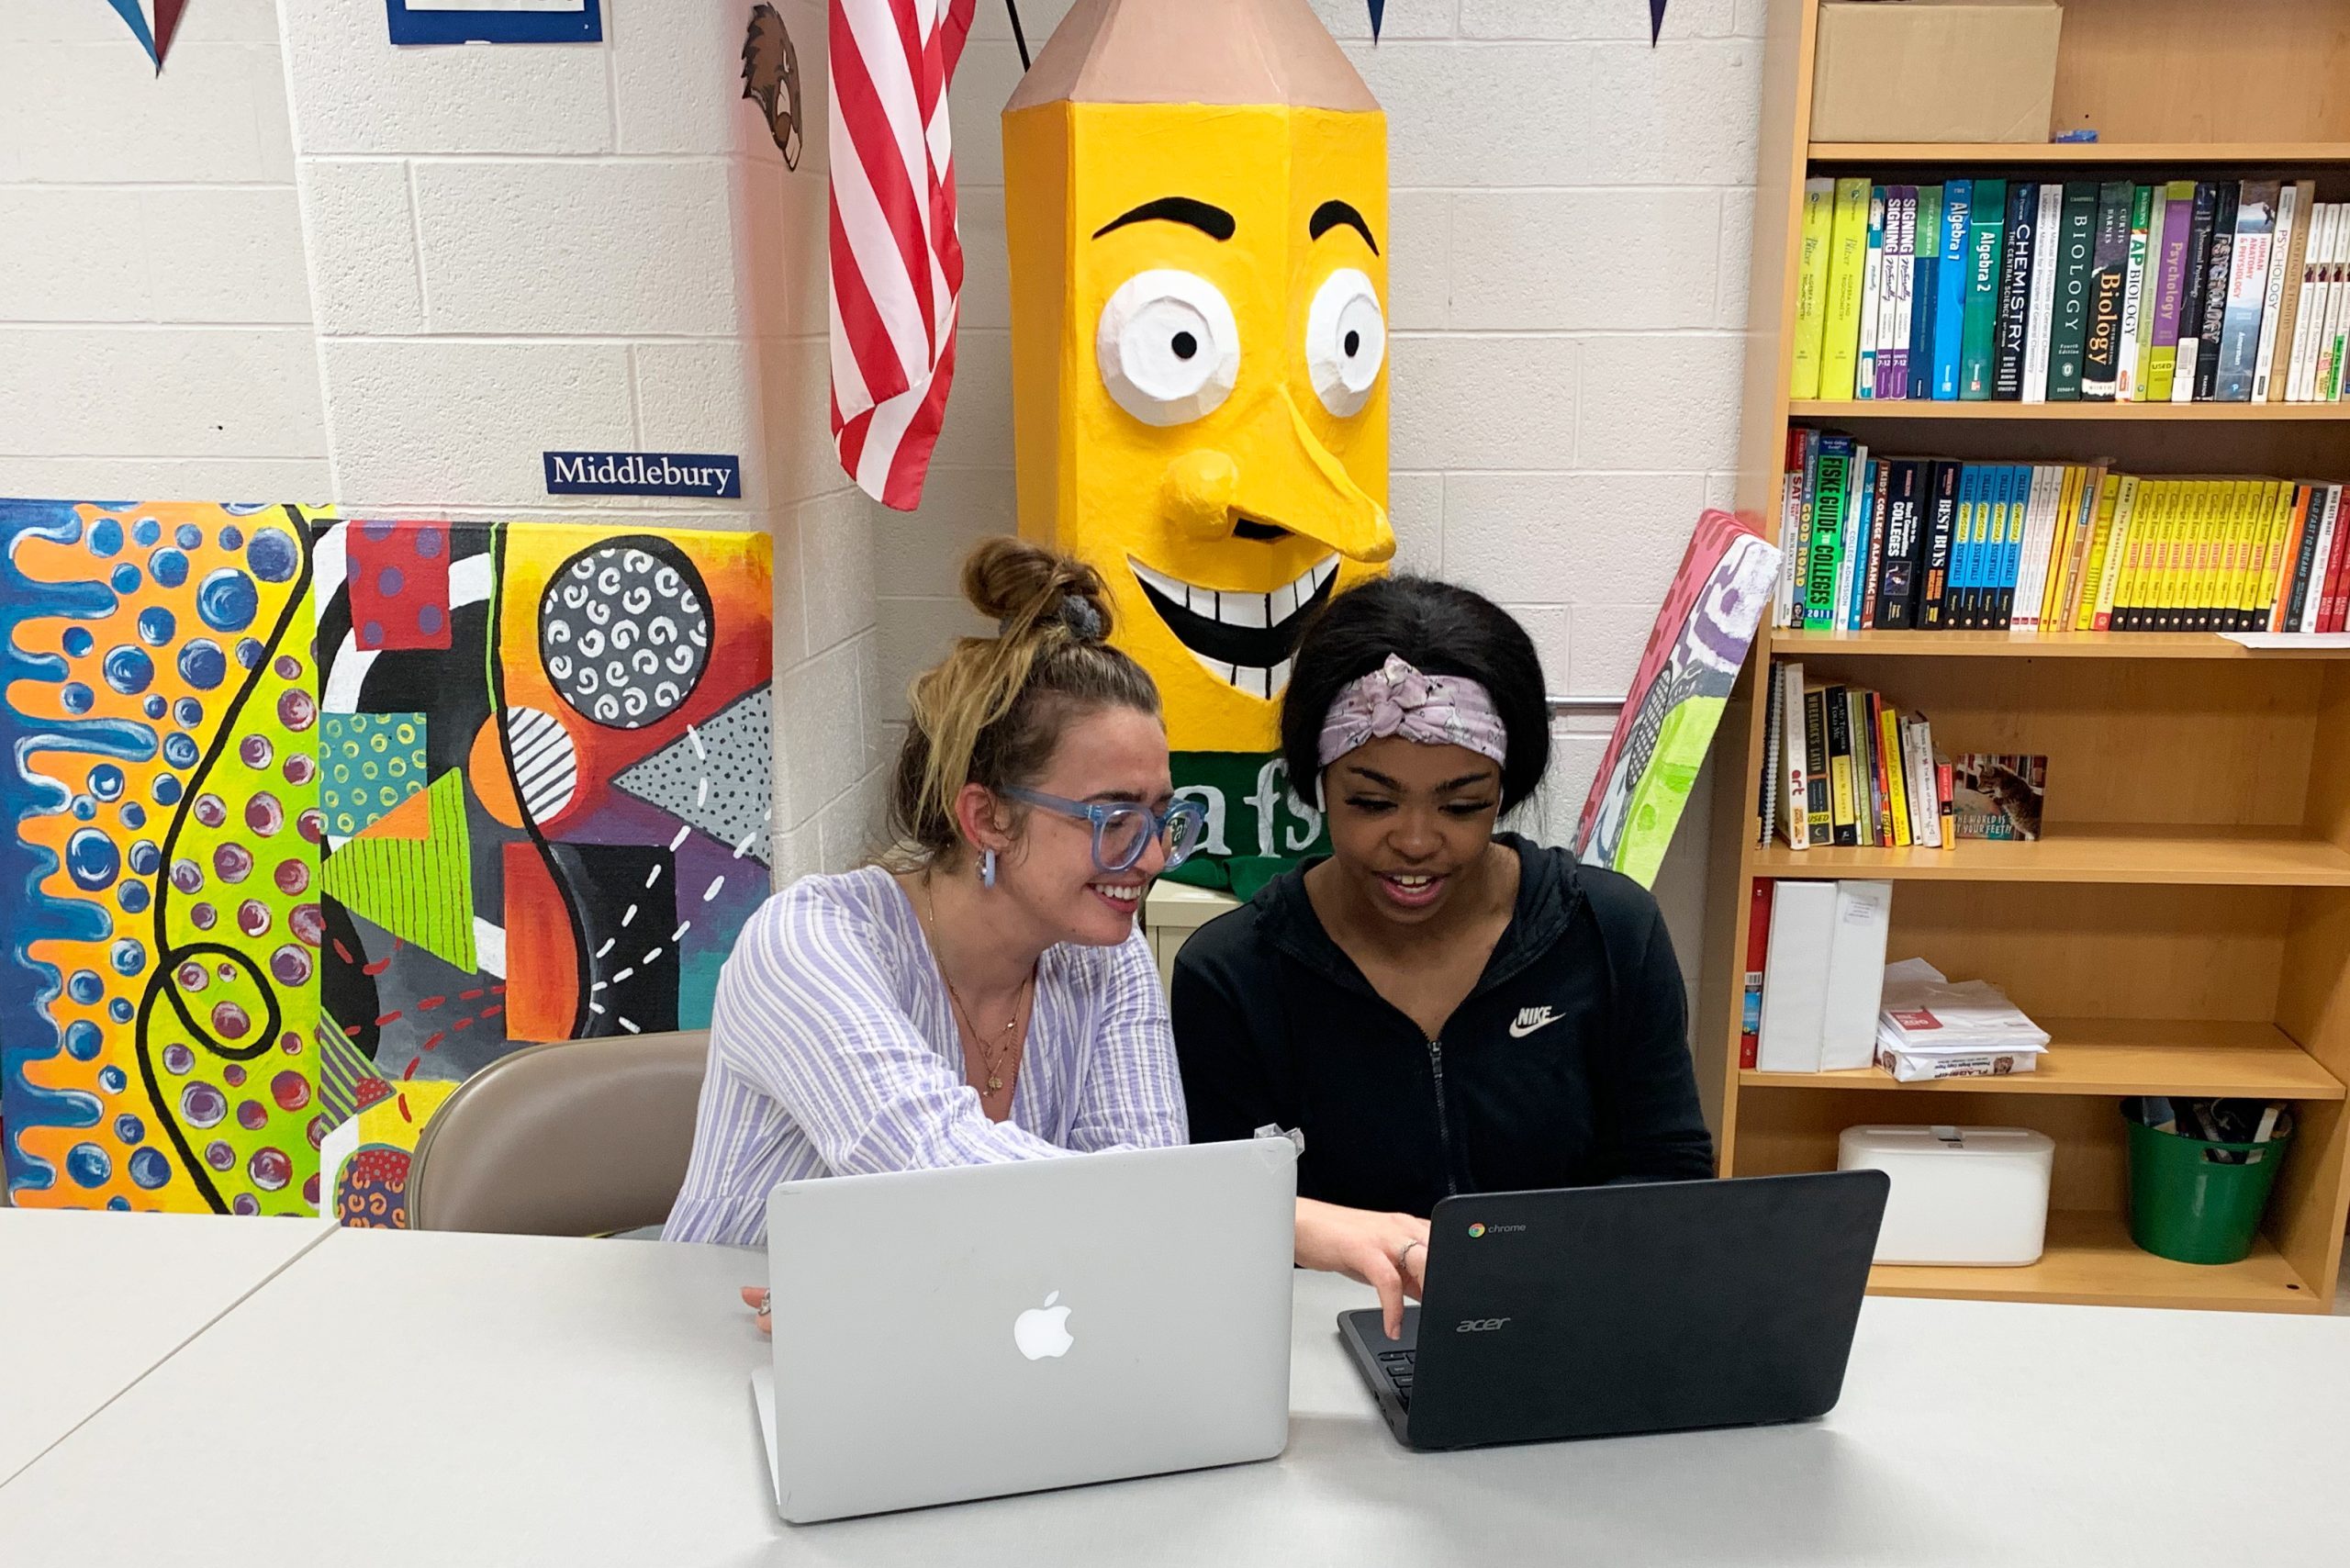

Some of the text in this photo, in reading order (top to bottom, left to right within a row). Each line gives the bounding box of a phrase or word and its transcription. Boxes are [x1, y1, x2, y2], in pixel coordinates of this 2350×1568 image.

[1947, 202, 1967, 251] Algebra
[2104, 208, 2115, 244] BARNES
[2117, 208, 2128, 244] CURTIS
[1883, 198, 1901, 302] SIGNING Naturally
[1897, 198, 1917, 302] SIGNING Naturally
[1975, 231, 1996, 292] Algebra 2
[2196, 229, 2208, 263] Abnormal
[2246, 237, 2257, 279] ANATOMY
[2256, 237, 2266, 272] HUMAN
[2007, 249, 2015, 284] CENTRAL
[2065, 216, 2088, 330] BIOLOGY
[2162, 241, 2185, 320] Psychology
[2190, 265, 2205, 298] Psychology
[2232, 245, 2246, 299] PHYSIOLOGY
[2268, 230, 2288, 310] PSYCHOLOGY
[2002, 286, 2011, 319] SCIENCE
[2008, 223, 2031, 353] CHEMISTRY
[2123, 238, 2145, 337] AP BIOLOGY
[2202, 232, 2232, 344] PSYCHOLOGY
[2314, 287, 2326, 324] Essentials
[2088, 273, 2121, 366] Biology
[2309, 332, 2321, 364] Sociology
[553, 455, 733, 496] Middlebury
[1791, 476, 1802, 501] SAT
[1804, 456, 1816, 493] choosing
[1936, 498, 1953, 532] BEST
[2311, 492, 2322, 514] HOLD
[2327, 505, 2336, 519] GETS
[2330, 490, 2339, 504] WHO
[1799, 502, 1812, 543] GOOD
[1809, 458, 1843, 604] FISKE GUIDE TO COLLEGES
[1873, 497, 1885, 539] COLLEGE
[1887, 501, 1906, 557] COLLEGES
[1899, 501, 1913, 557] Most Competitive
[2133, 493, 2150, 540] College Essay
[2147, 493, 2164, 540] College Essay
[2161, 493, 2177, 540] College Essay
[2175, 493, 2191, 540] College Essay
[2188, 493, 2205, 540] College Essay
[2203, 493, 2219, 540] College Essay
[2215, 493, 2232, 540] College Essay
[2230, 493, 2245, 540] College Essay
[2244, 493, 2259, 540] College Essay
[2258, 495, 2274, 542] College Essay
[2276, 493, 2292, 540] College Essay
[2307, 515, 2318, 533] FAST
[2324, 521, 2334, 536] WHAT
[1787, 532, 1796, 566] BIOLOGY
[1846, 530, 1856, 563] COLLEGE
[1931, 535, 1948, 567] BUYS
[2103, 510, 2127, 606] The Passionate Teacher
[2305, 535, 2314, 545] TO
[1796, 546, 1808, 588] ROAD
[1867, 543, 1883, 595] ALMANAC
[1953, 543, 1964, 581] ESSENTIALS
[1970, 543, 1982, 581] ESSENTIALS
[1986, 543, 1999, 581] ESSENTIALS
[2004, 543, 2018, 581] ESSENTIALS
[2299, 546, 2313, 578] DREAMS
[1841, 566, 1852, 607] ADMISSION
[1807, 610, 1833, 620] 2011
[2324, 597, 2333, 615] FRANK
[1807, 697, 1821, 745] WHEELOCK'S
[1809, 748, 1822, 772] LATIN
[1791, 769, 1806, 796] art
[1891, 780, 1899, 797] BOOK
[1807, 814, 1830, 823] USED
[1882, 814, 1891, 835] USED
[1964, 824, 1984, 834] YOUR
[1970, 814, 1997, 824] WORLD
[1998, 814, 2006, 824] IS
[1516, 1005, 1553, 1026] NIKE
[1934, 1069, 1988, 1079] FLAGSHIP
[1488, 1225, 1527, 1234] chrome
[1456, 1317, 1512, 1333] acer
